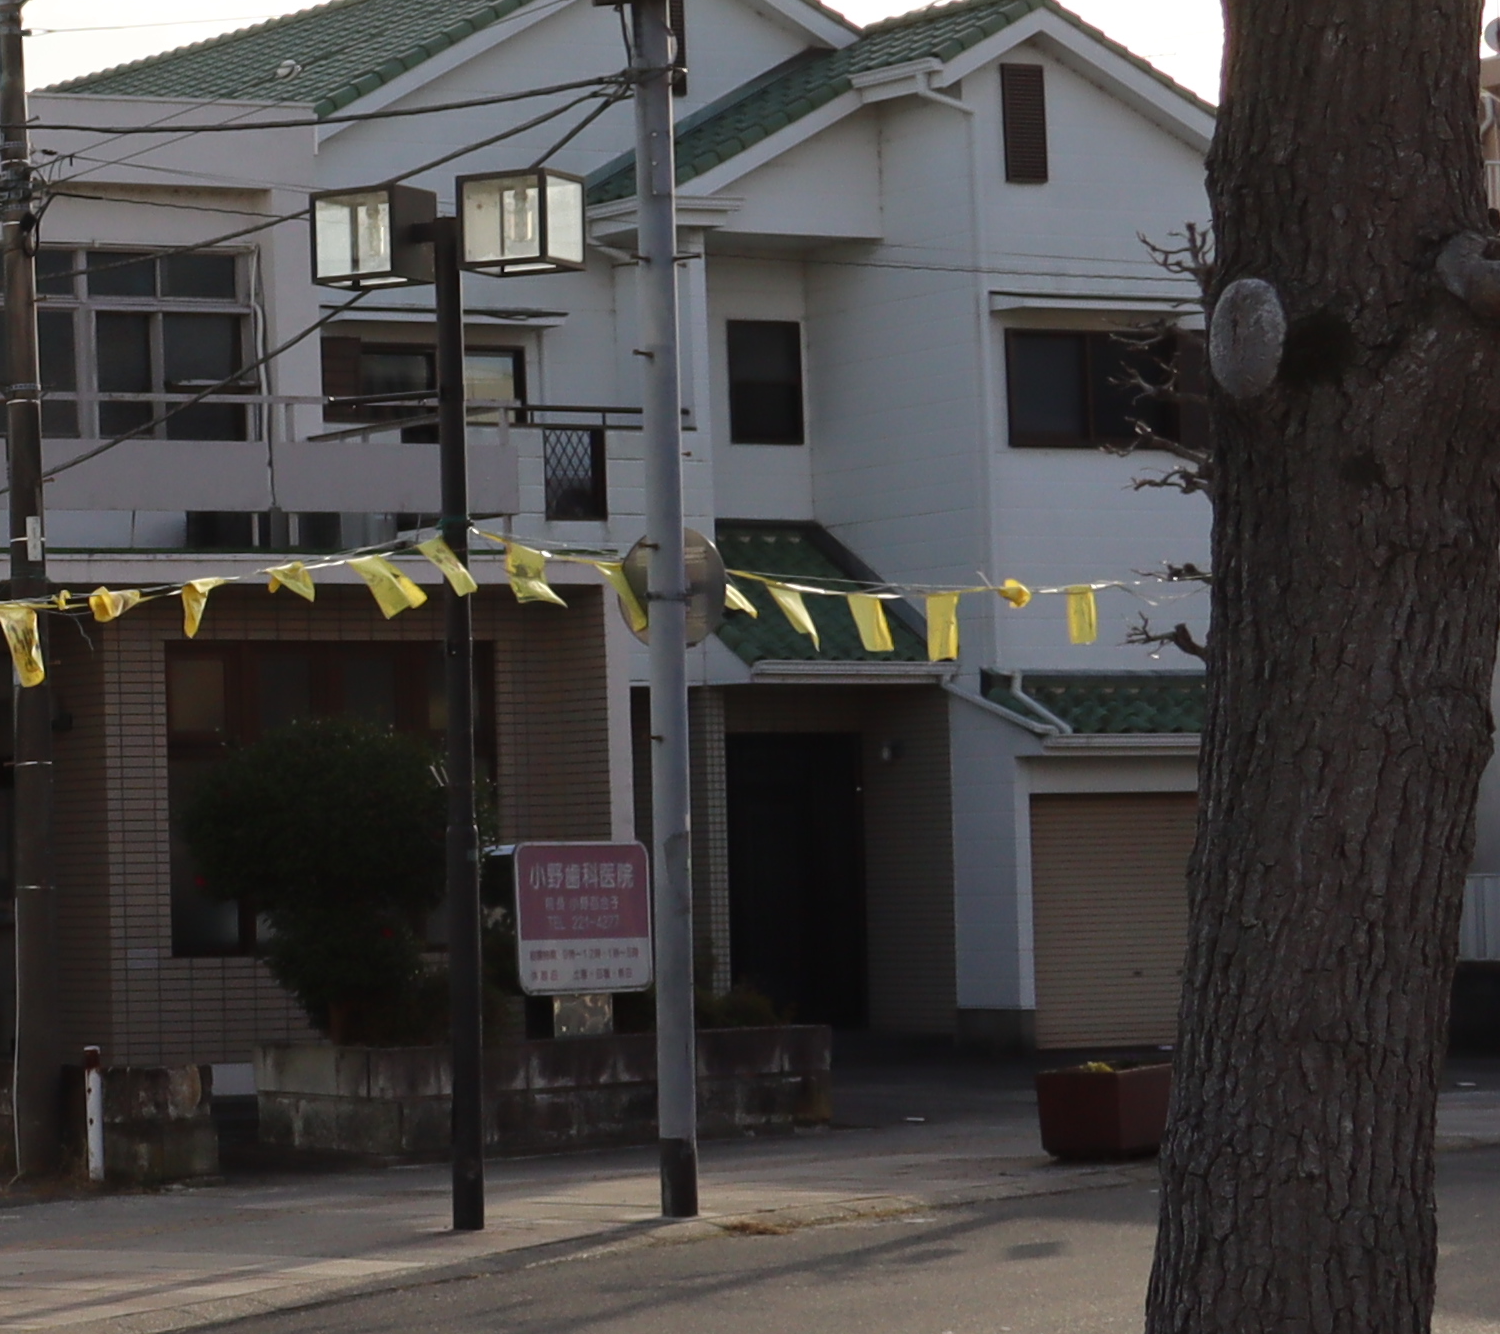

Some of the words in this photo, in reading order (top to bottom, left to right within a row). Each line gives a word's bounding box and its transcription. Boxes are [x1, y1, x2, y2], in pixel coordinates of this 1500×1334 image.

[529, 862, 634, 890] 小野歯科医院
